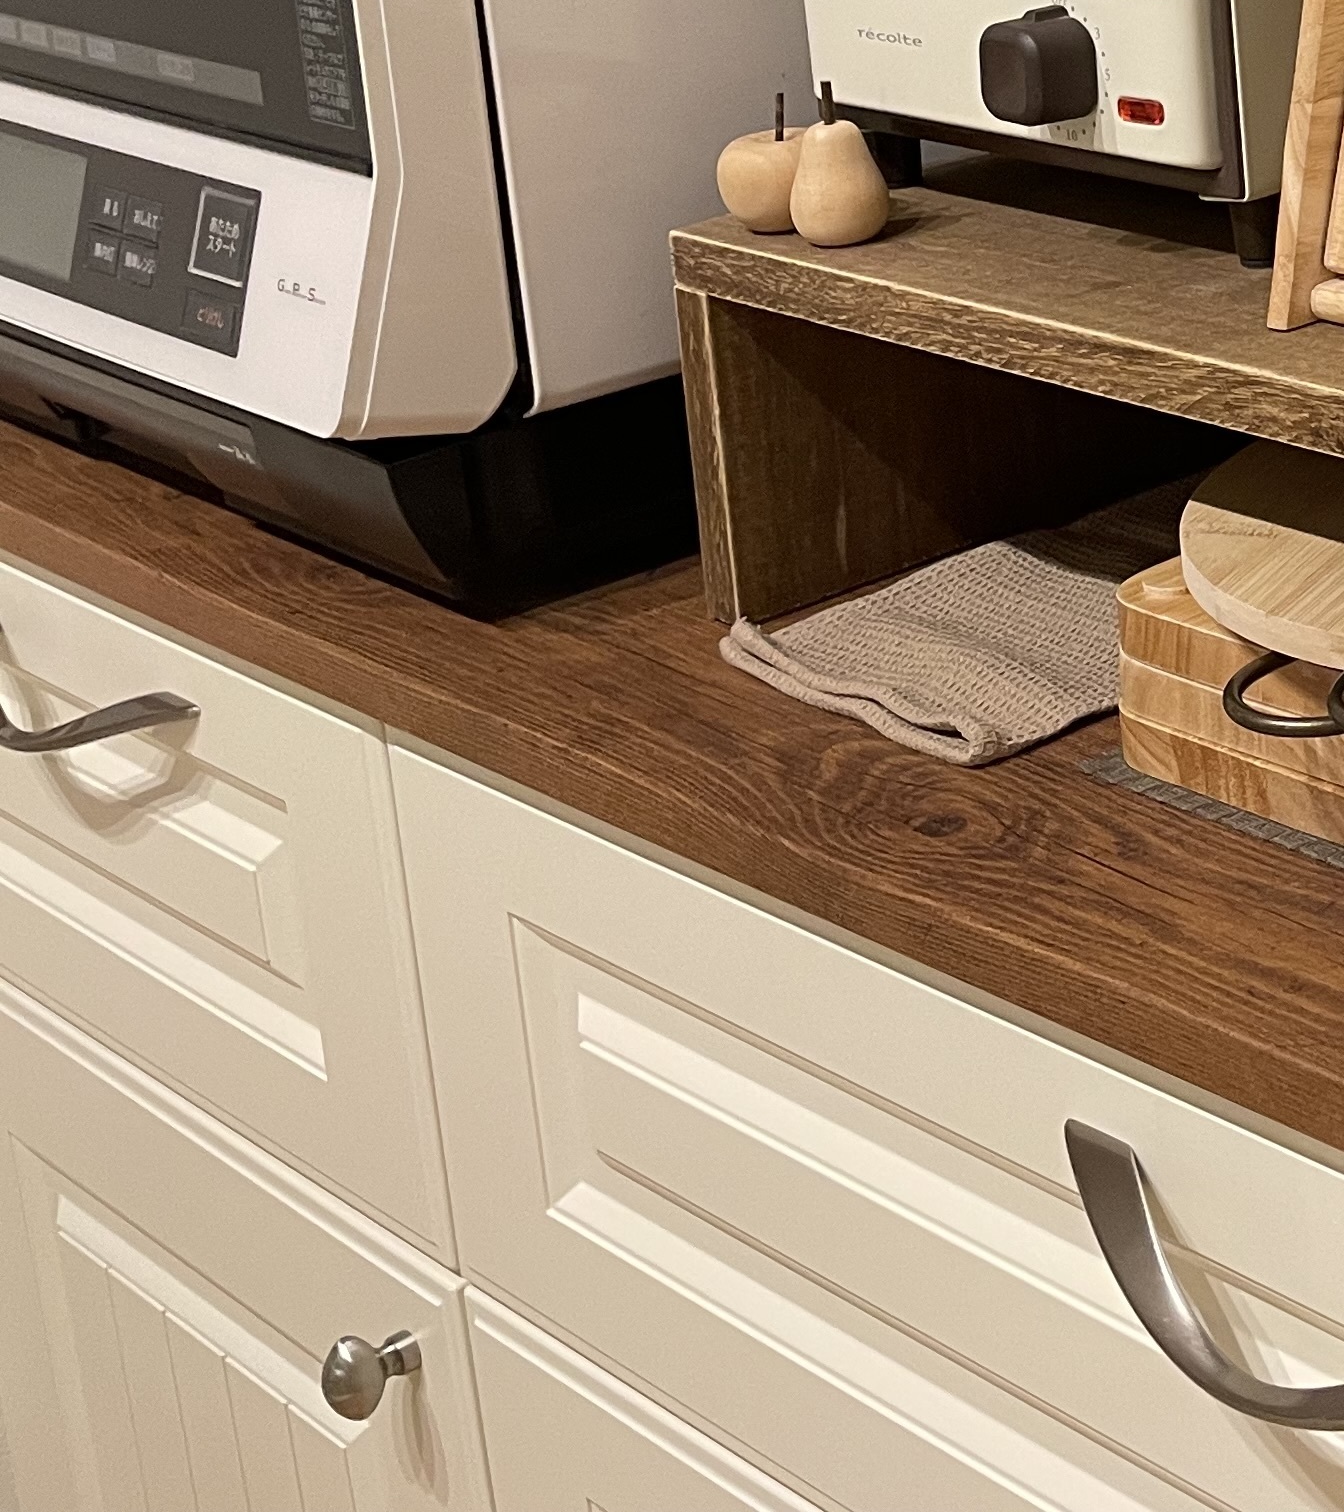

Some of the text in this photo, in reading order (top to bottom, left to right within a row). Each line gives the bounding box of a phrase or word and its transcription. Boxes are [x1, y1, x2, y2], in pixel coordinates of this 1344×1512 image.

[856, 26, 923, 48] récolte
[1094, 27, 1101, 40] 3
[1105, 68, 1111, 82] 5
[1065, 129, 1078, 142] 10
